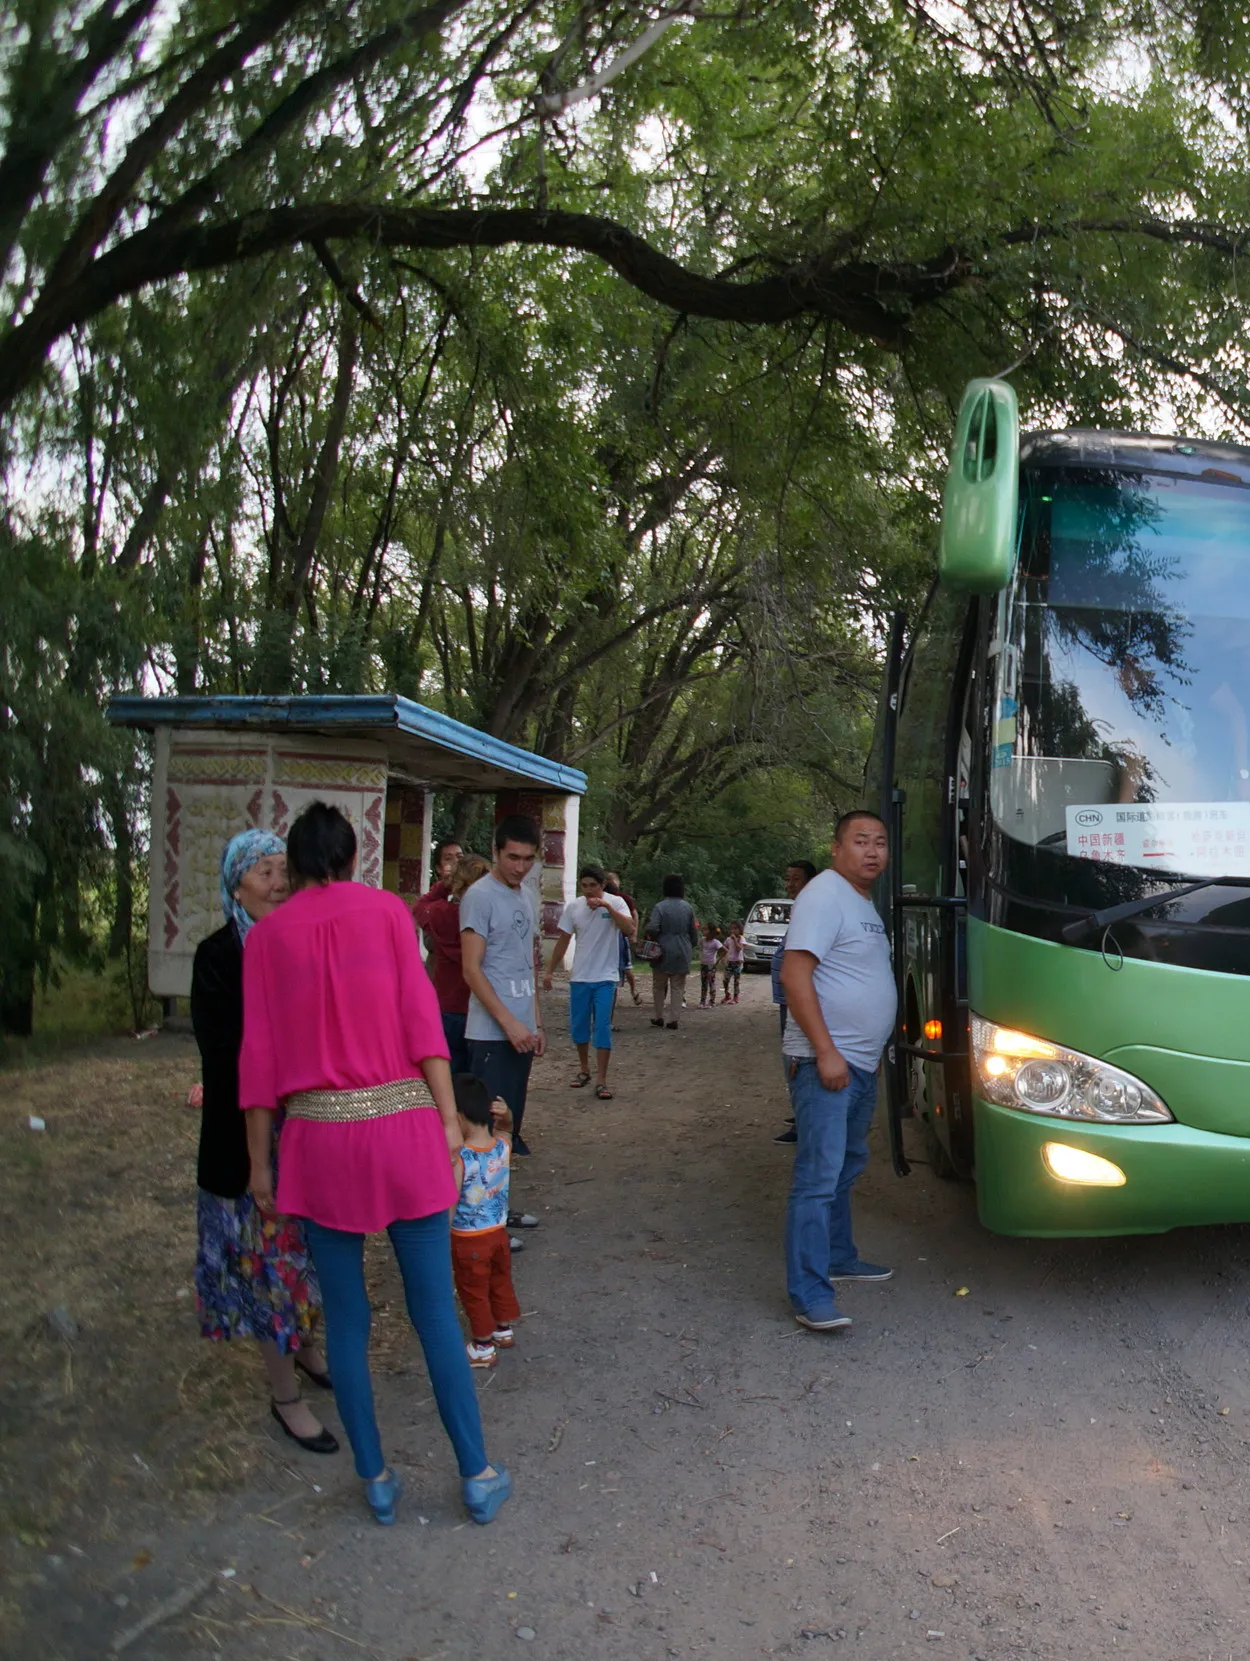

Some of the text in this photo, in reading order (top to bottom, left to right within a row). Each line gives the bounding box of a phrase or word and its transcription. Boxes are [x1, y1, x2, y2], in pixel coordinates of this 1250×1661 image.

[1078, 814, 1100, 823] CHN
[1078, 832, 1125, 847] 中国新疆
